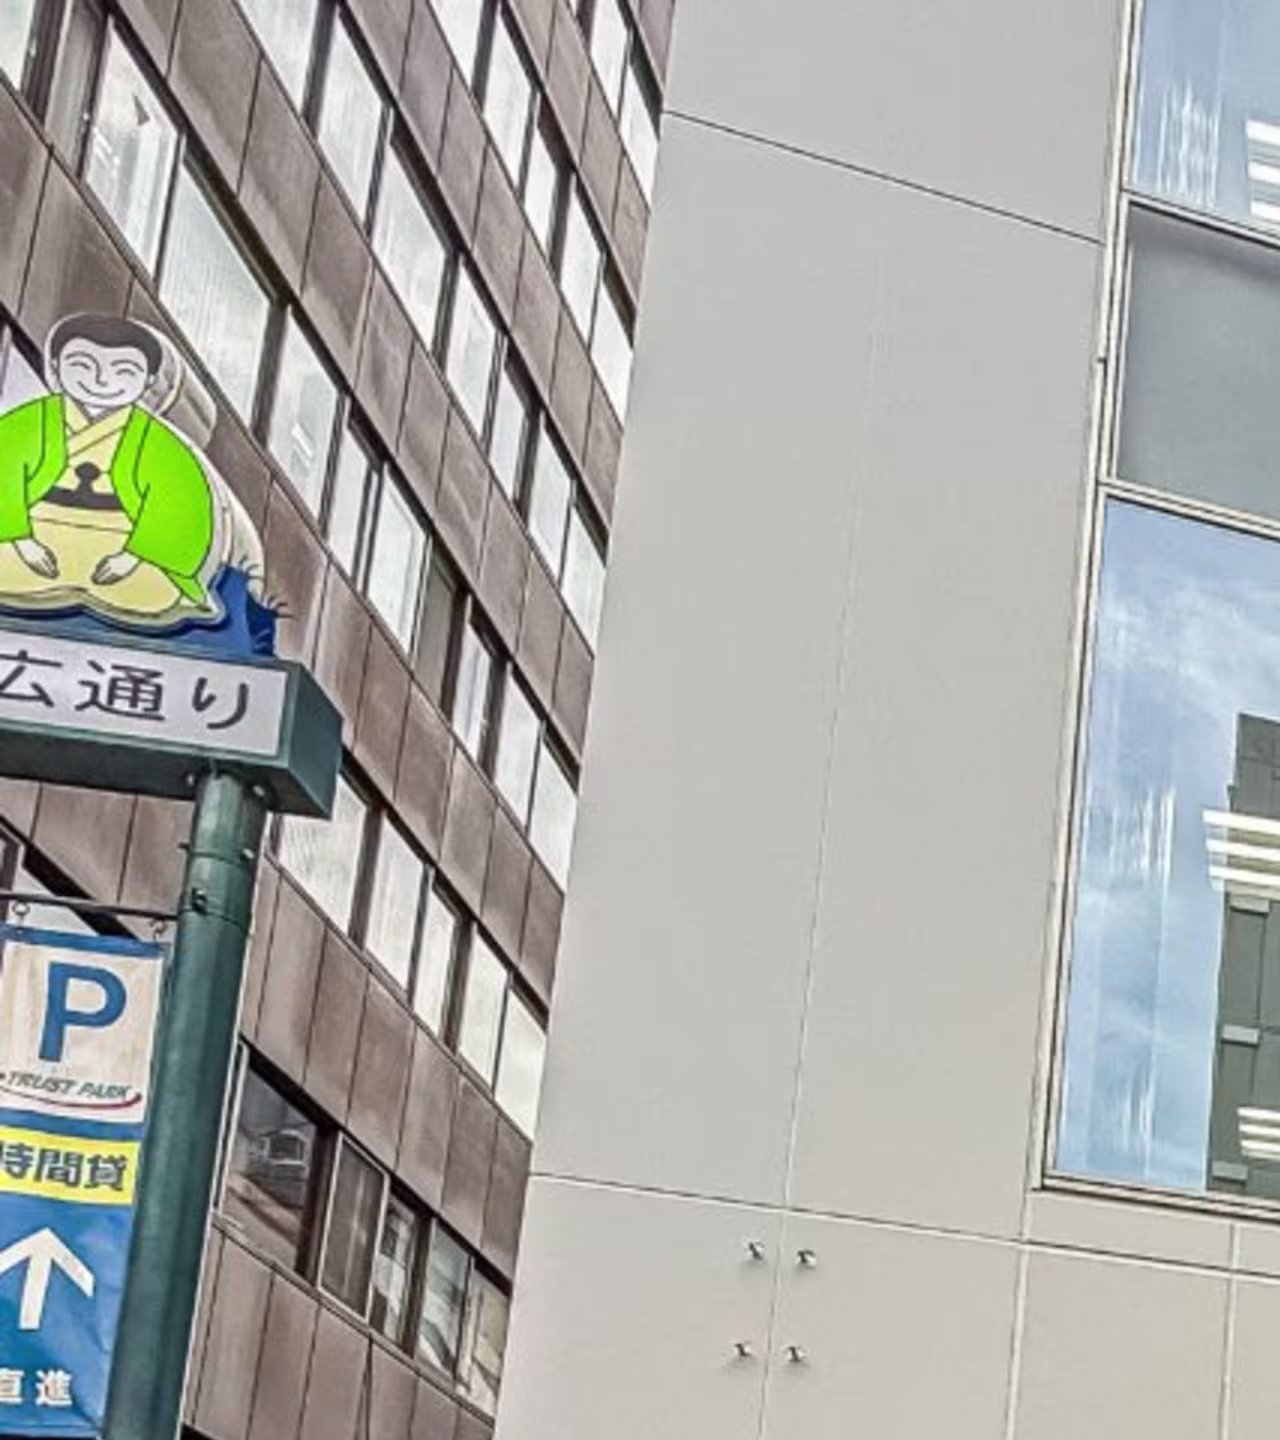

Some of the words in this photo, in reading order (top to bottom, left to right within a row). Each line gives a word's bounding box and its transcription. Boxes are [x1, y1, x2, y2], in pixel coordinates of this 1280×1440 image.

[0, 649, 250, 730] 広通り
[38, 960, 127, 1063] P
[8, 1071, 77, 1095] TRUST
